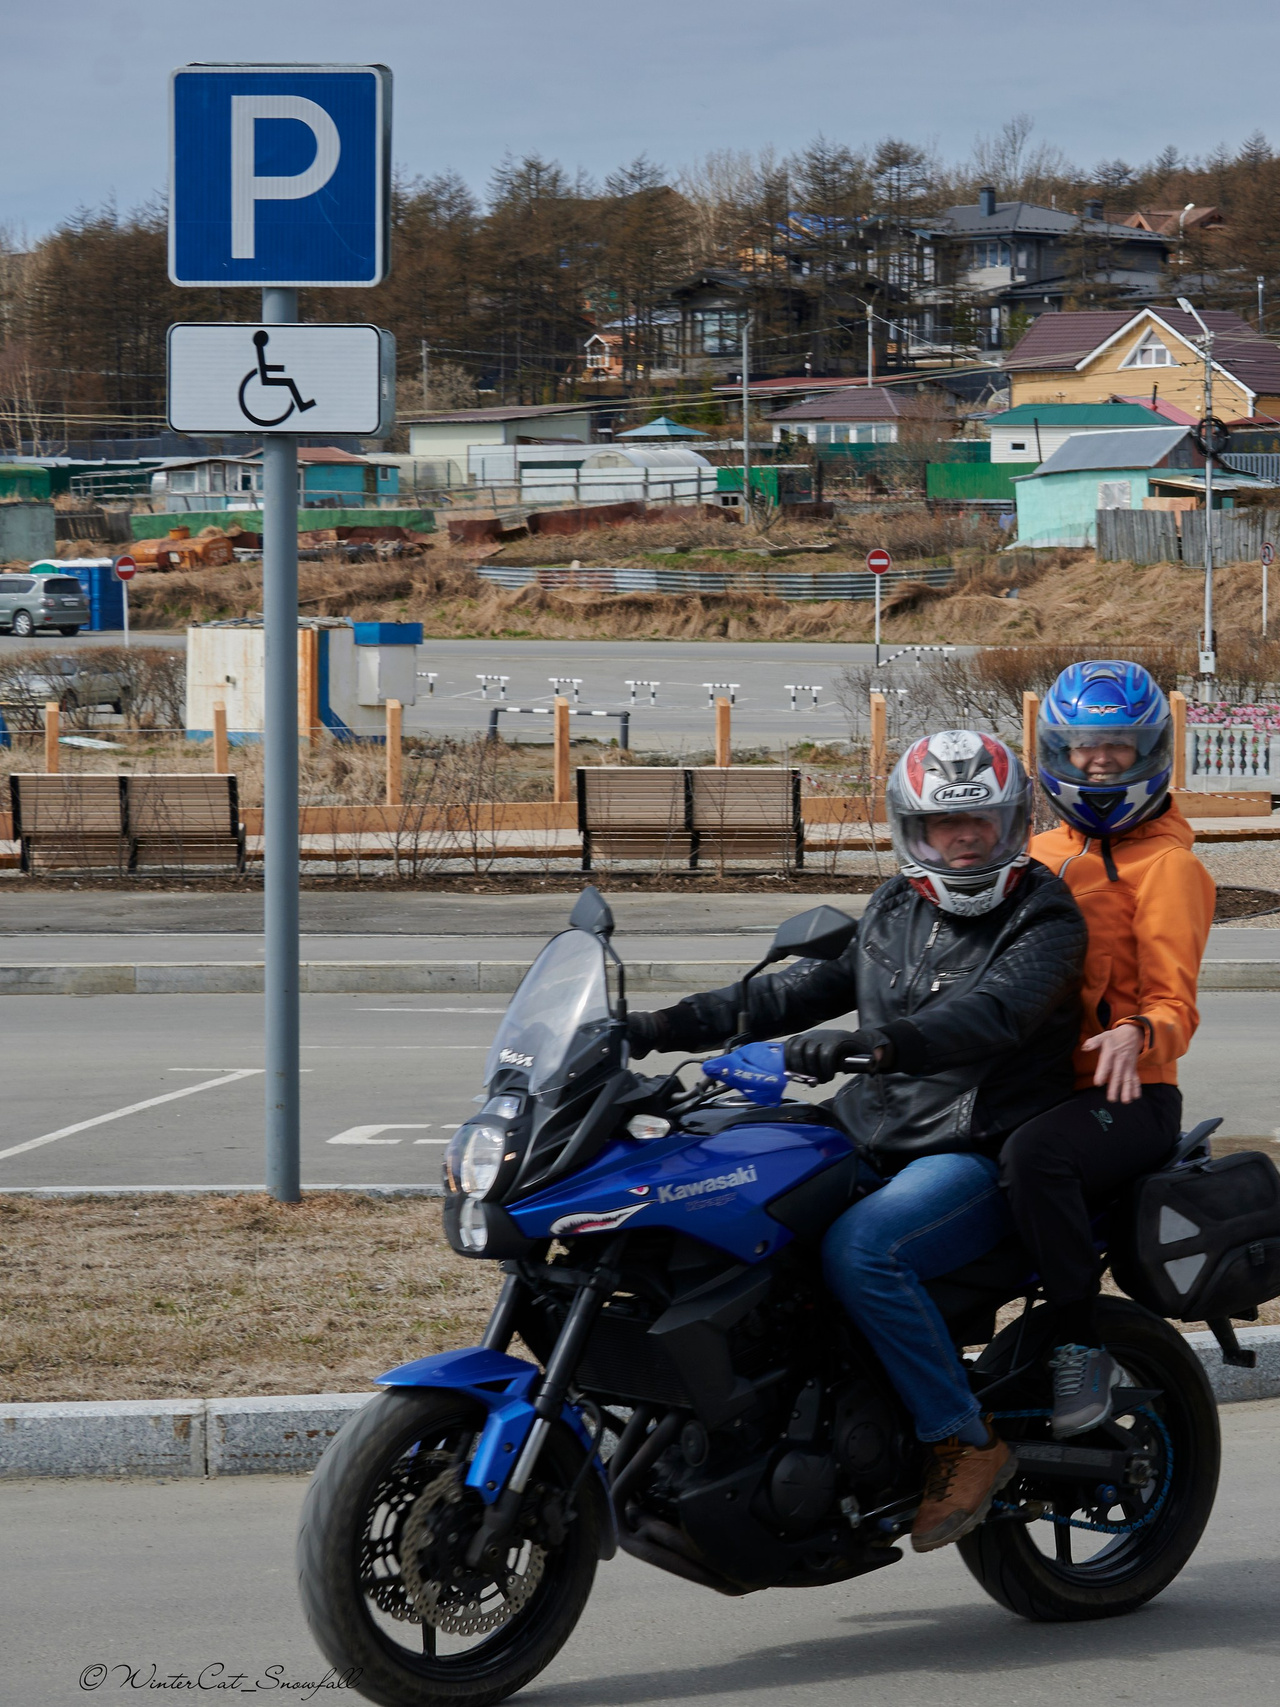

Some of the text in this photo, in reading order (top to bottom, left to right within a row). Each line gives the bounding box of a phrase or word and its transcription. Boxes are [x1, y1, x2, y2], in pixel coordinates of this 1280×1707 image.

[231, 94, 342, 259] P
[941, 787, 981, 800] HJC
[656, 1163, 758, 1204] Kawasaki
